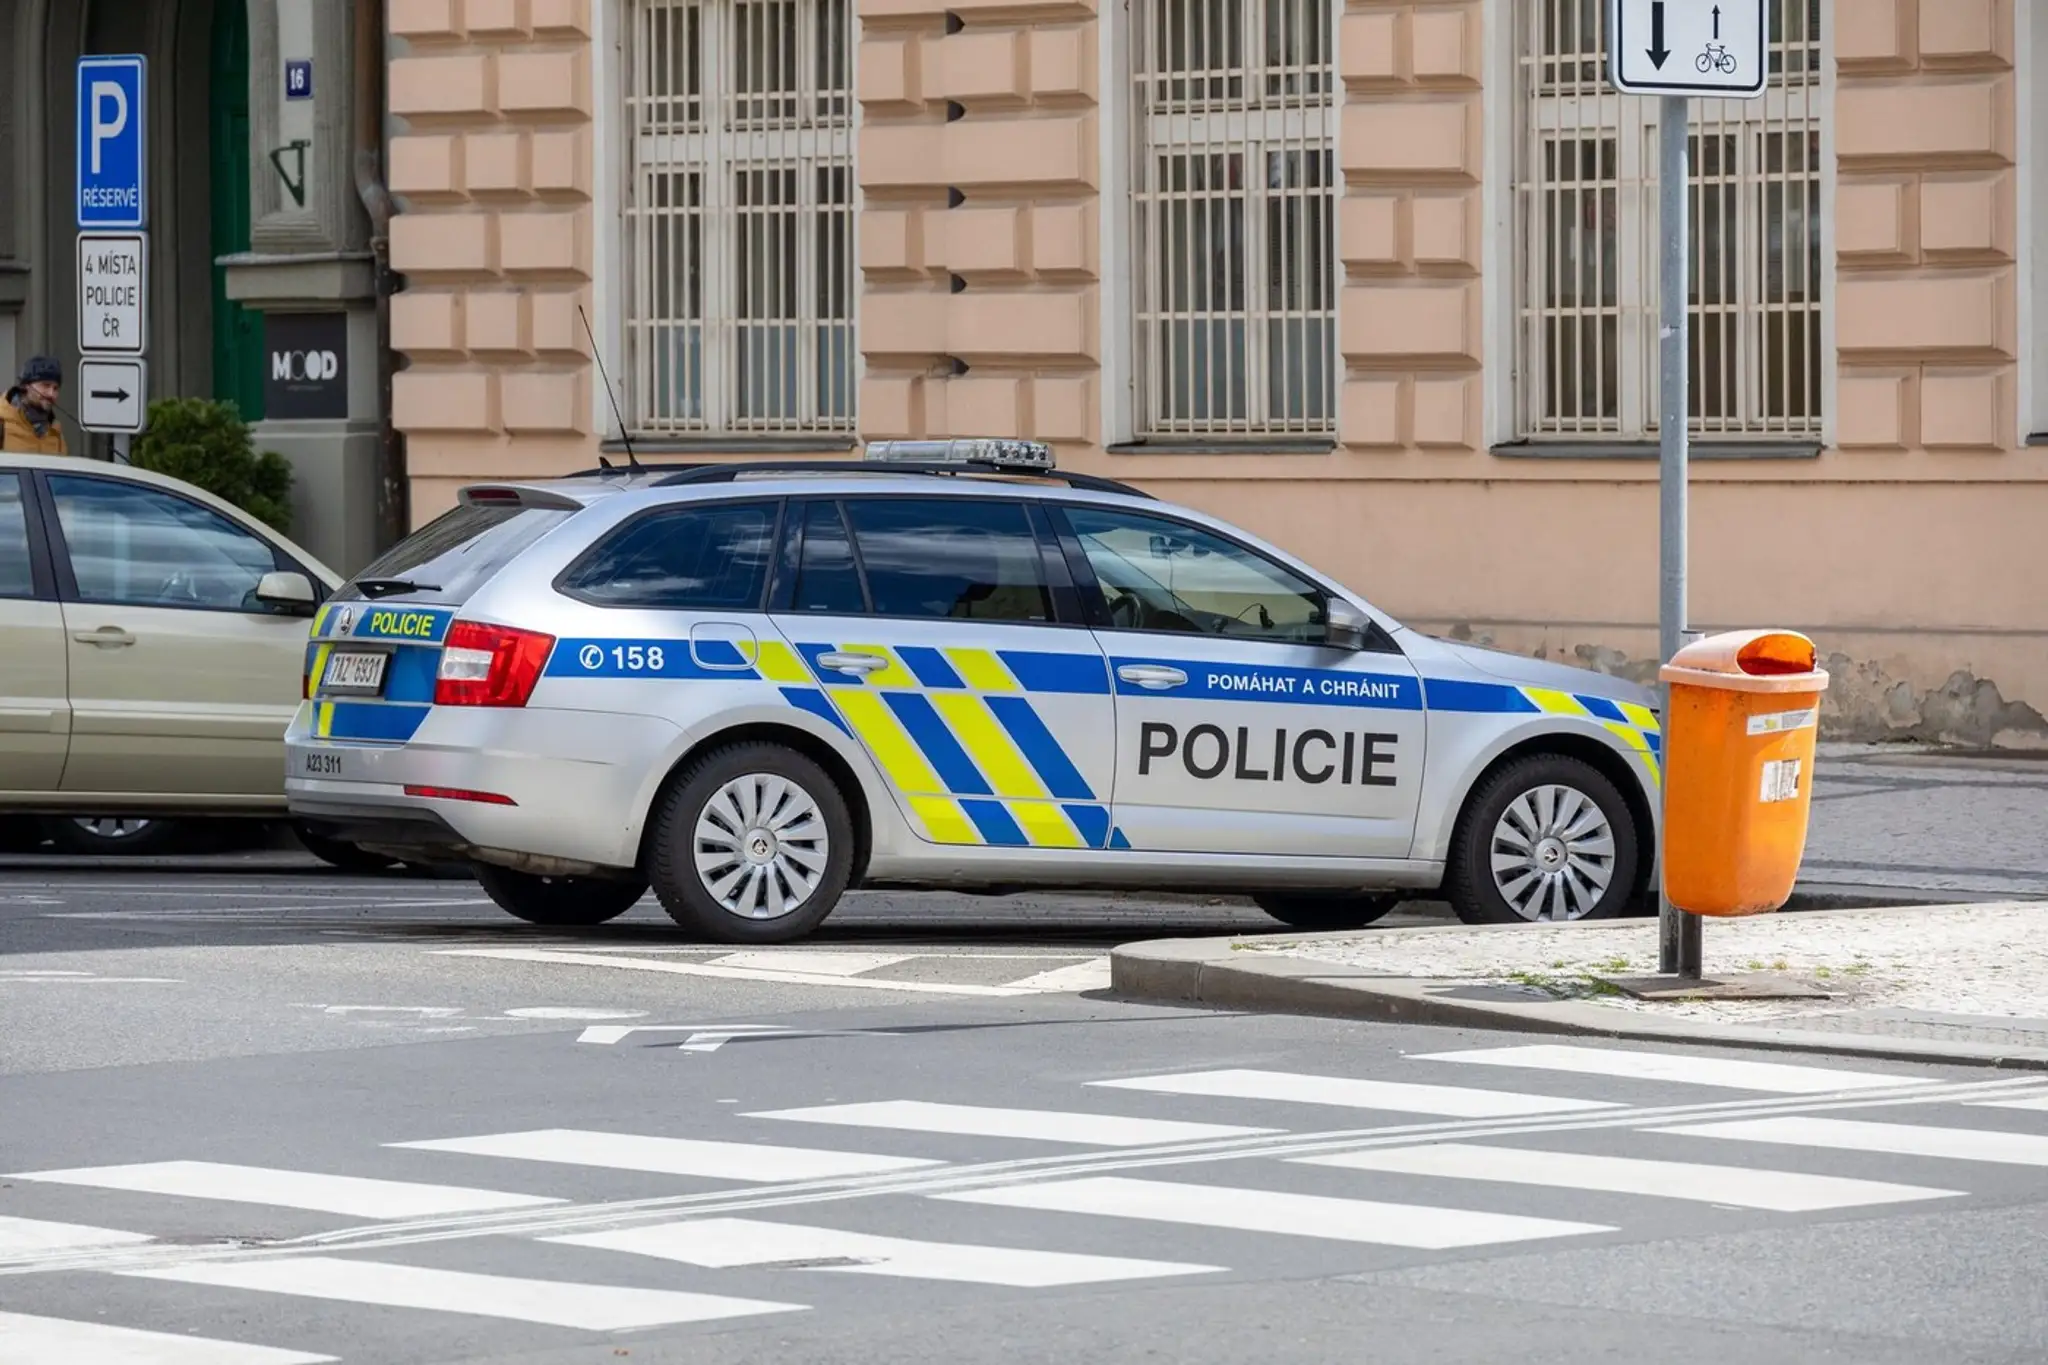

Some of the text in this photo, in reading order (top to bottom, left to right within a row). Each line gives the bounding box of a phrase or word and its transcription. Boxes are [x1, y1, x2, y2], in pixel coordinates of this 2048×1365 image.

[290, 67, 304, 90] 16
[91, 80, 128, 175] P
[82, 183, 138, 208] RÉSERVÉ
[84, 250, 137, 275] 4 MÍSTA
[86, 286, 136, 306] POLICIE
[101, 313, 120, 338] ČR
[272, 350, 338, 381] MOOD
[370, 612, 435, 637] POLICIE
[611, 646, 665, 670] 158
[1207, 672, 1400, 698] POMÁHAT A CHRÁNIT
[324, 755, 341, 774] 311
[1138, 722, 1399, 787] POLICIE
